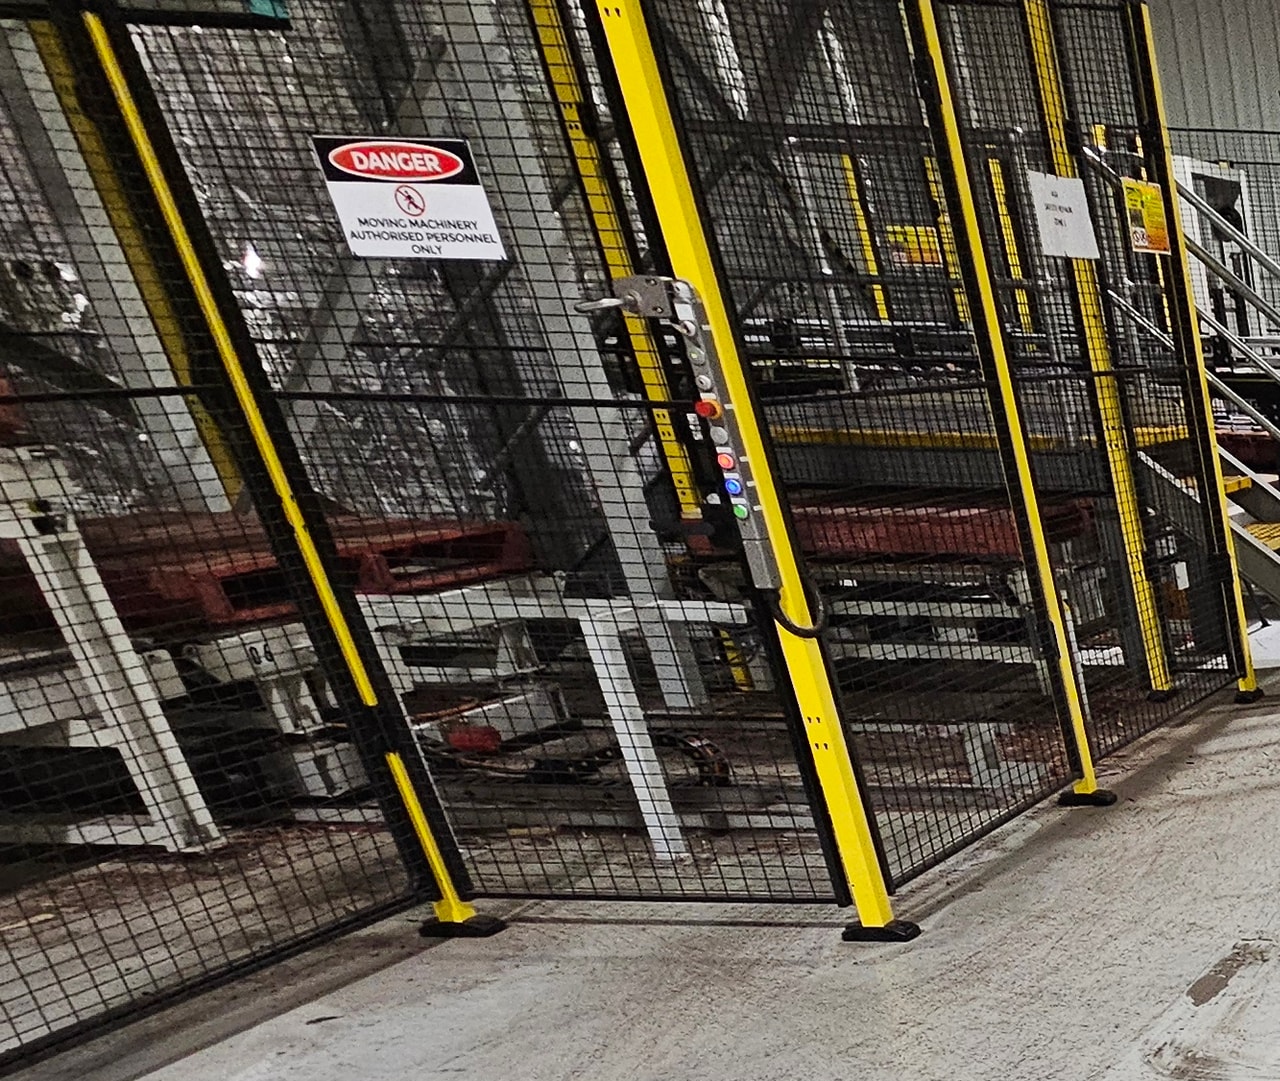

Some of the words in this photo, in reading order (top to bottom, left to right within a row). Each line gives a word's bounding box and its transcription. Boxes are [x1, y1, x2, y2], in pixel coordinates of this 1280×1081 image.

[350, 151, 442, 173] DANGER
[357, 217, 408, 229] MOVING
[409, 218, 479, 231] MACHINERY
[350, 230, 423, 243] AUTHORISED
[426, 232, 498, 244] PERSONNEL
[411, 244, 443, 256] ONLY
